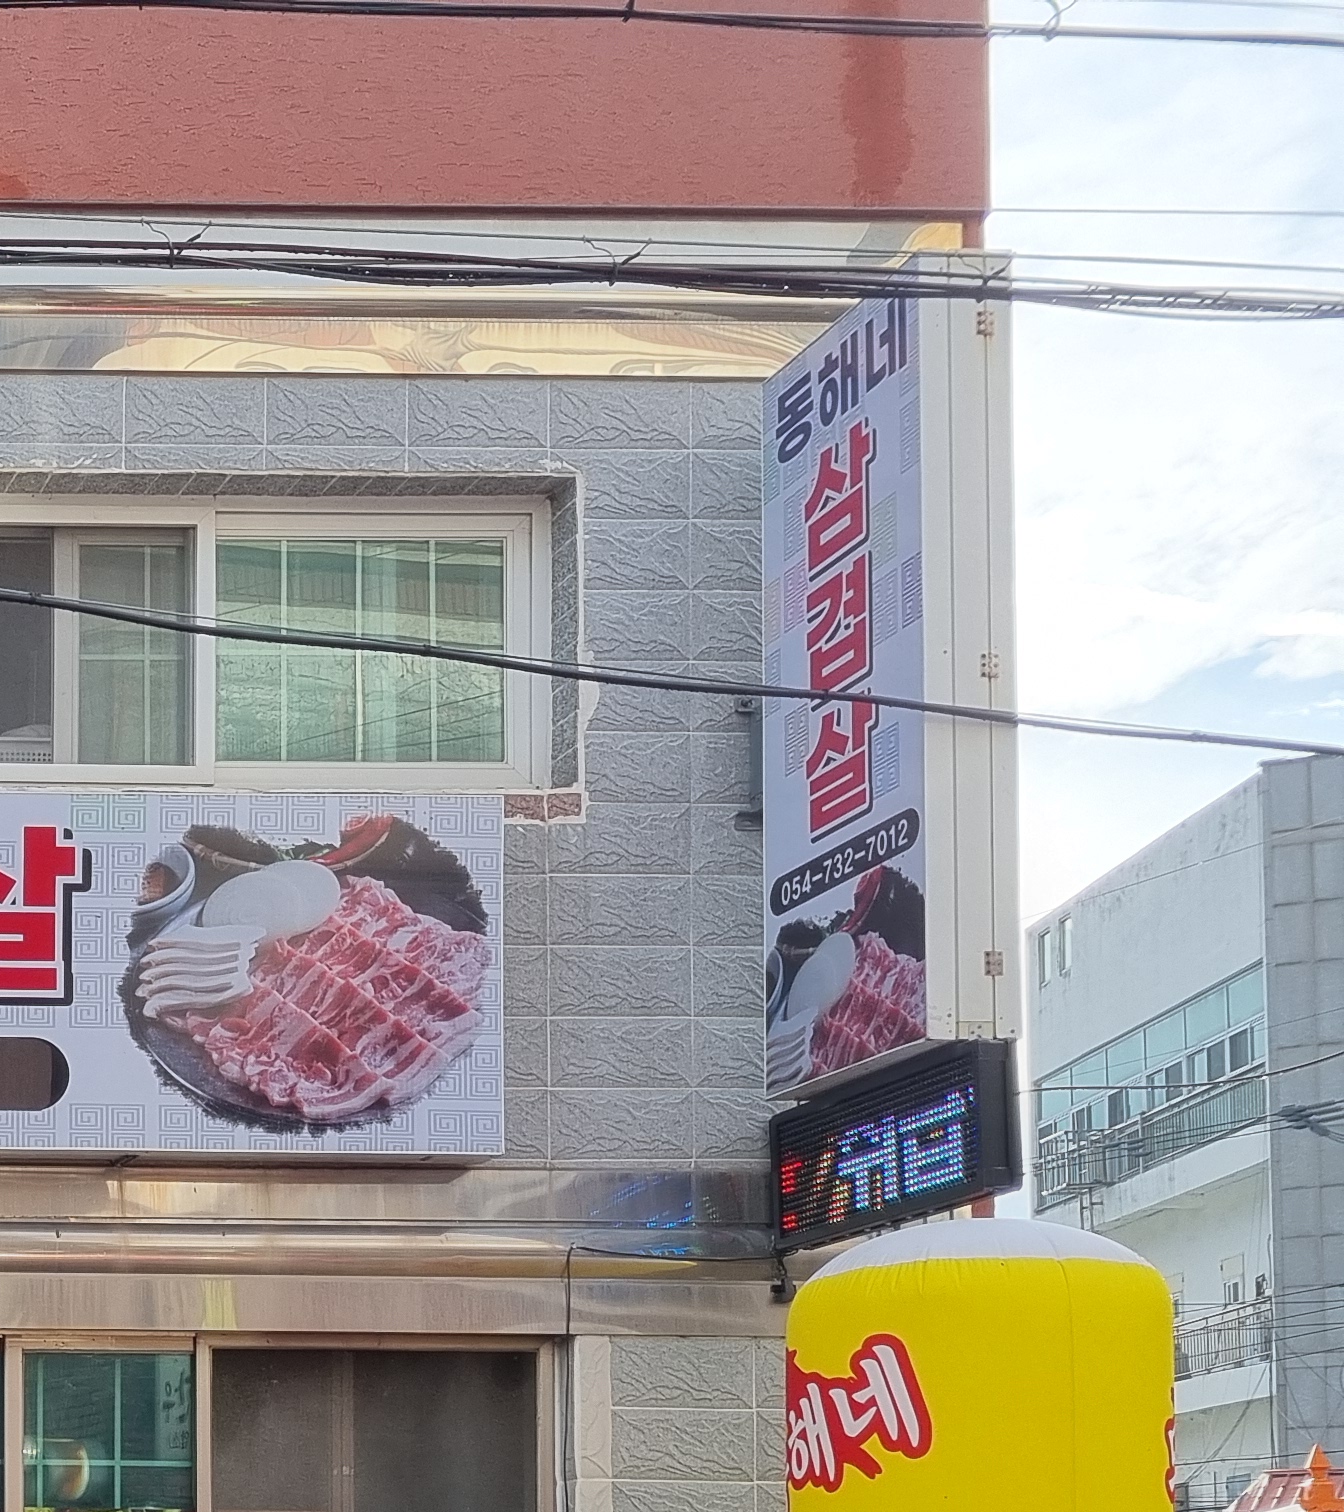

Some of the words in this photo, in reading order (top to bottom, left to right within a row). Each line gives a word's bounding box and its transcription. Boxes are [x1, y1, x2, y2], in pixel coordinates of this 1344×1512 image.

[776, 299, 908, 464] 동해네
[804, 418, 878, 843] 삼겹살
[781, 818, 908, 905] 054-732-7012
[786, 1344, 920, 1483] 해네
